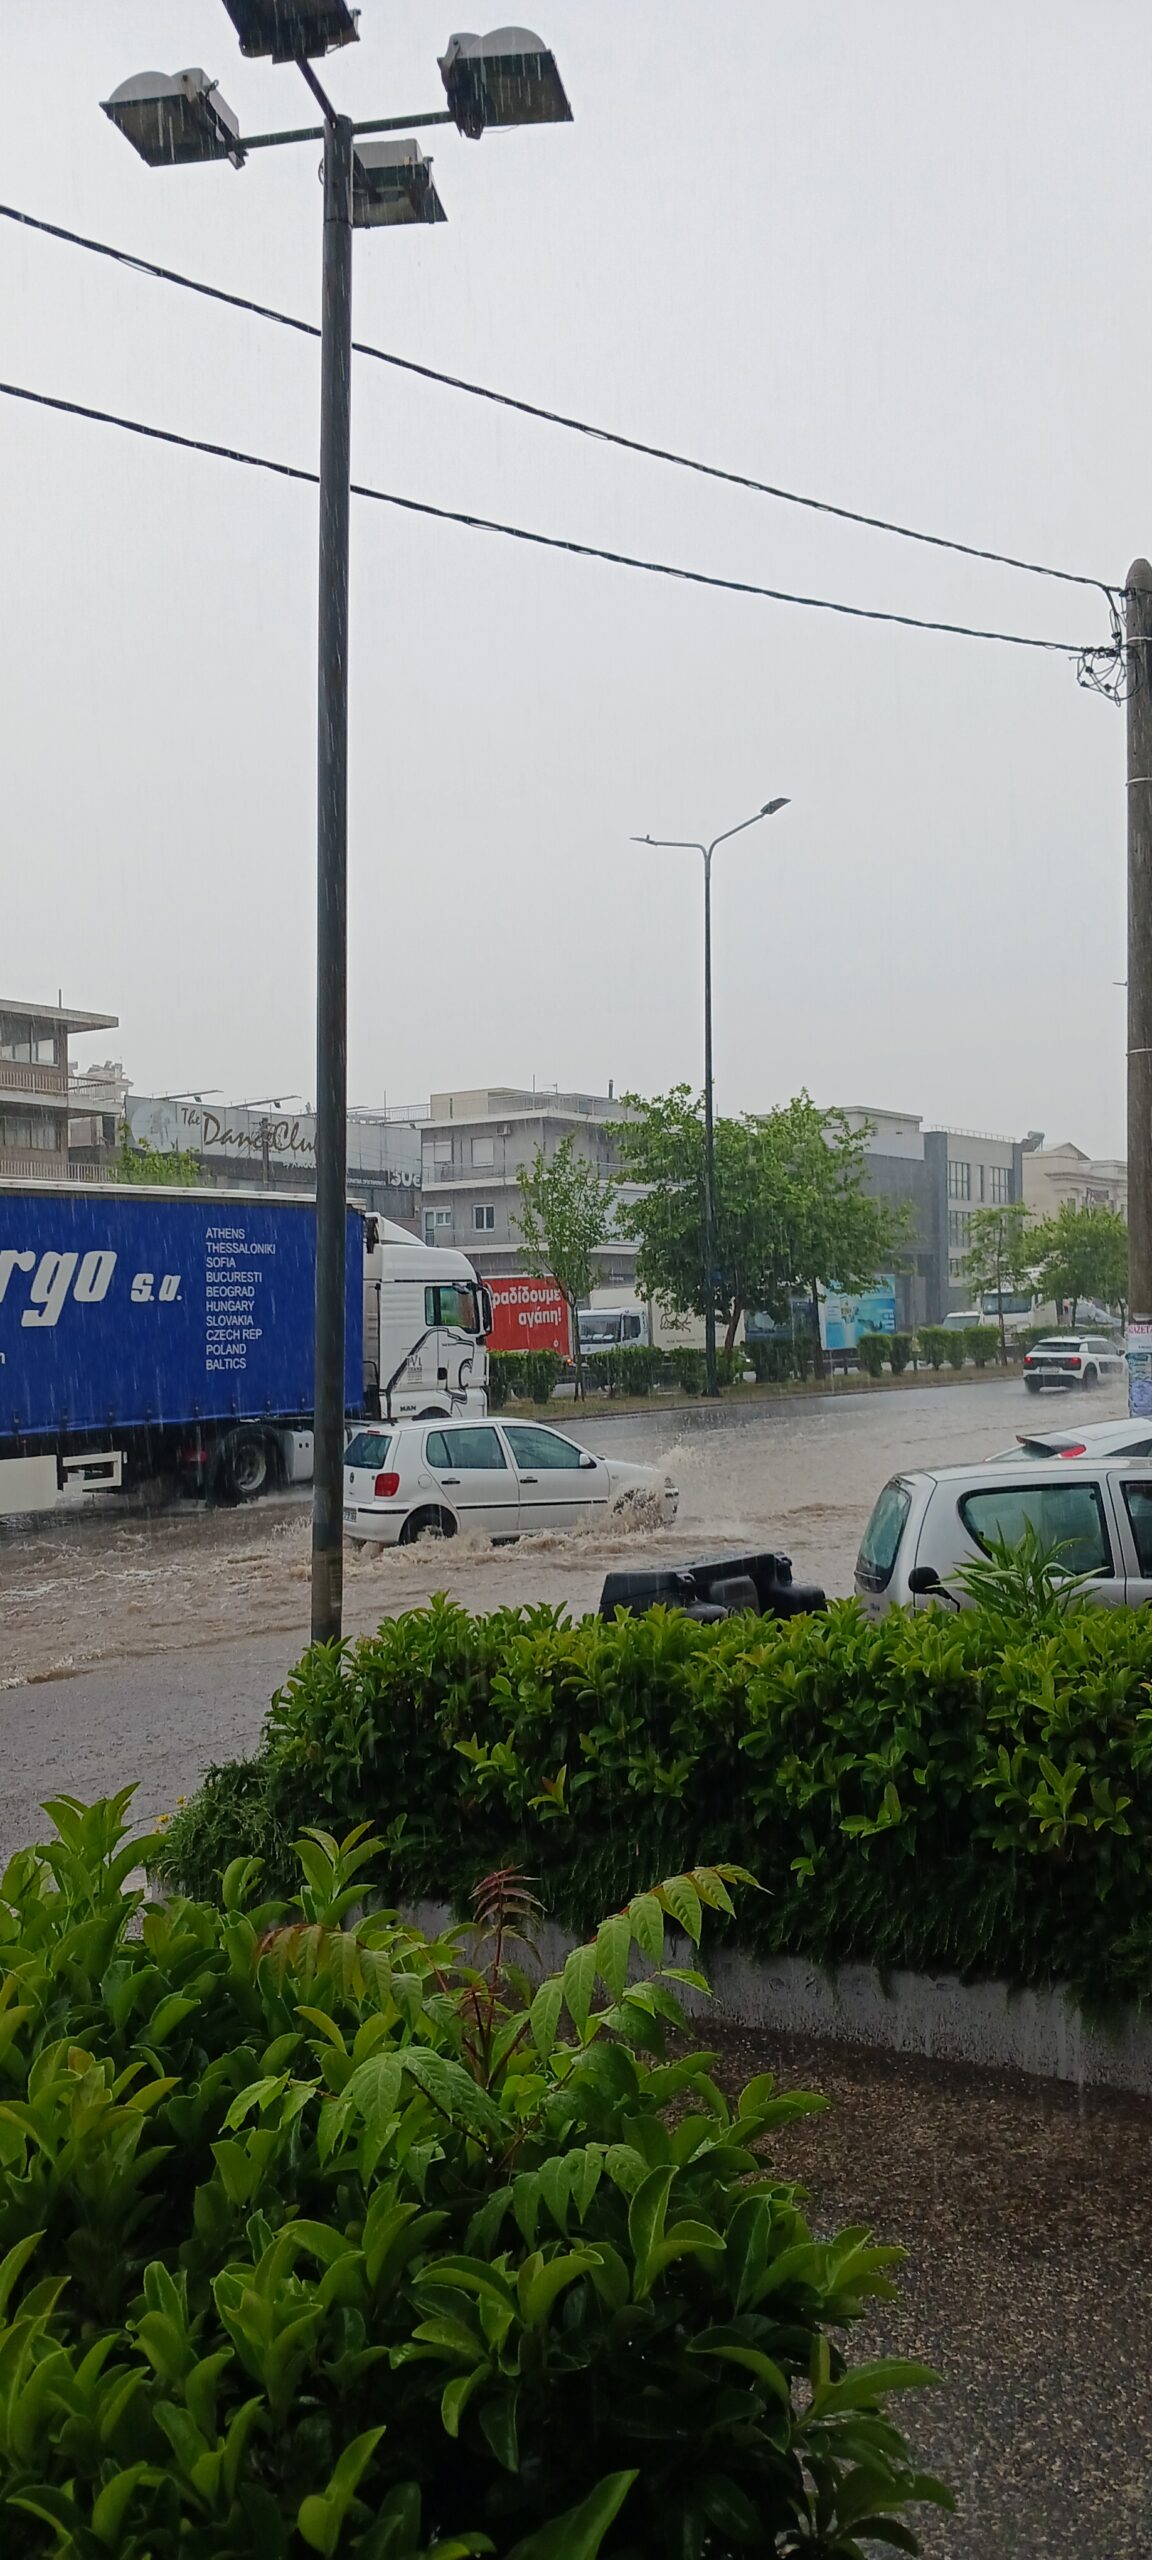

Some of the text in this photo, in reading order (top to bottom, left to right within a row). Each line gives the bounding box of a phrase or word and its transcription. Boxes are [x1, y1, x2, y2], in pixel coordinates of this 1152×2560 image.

[181, 1108, 200, 1127] The
[206, 1227, 246, 1240] ATHENS
[206, 1242, 276, 1255] THESSALONIKI
[206, 1256, 237, 1268] SOFIA
[206, 1271, 263, 1283] BUCURESTI
[206, 1286, 255, 1297] BEOGRAD
[206, 1300, 255, 1312] HUNGARY
[206, 1315, 254, 1327] SLOVAKIA
[518, 1306, 562, 1328] αγάπη!
[206, 1328, 263, 1341] CZECH REP
[206, 1343, 247, 1356] POLAND
[206, 1358, 247, 1370] BALTICS
